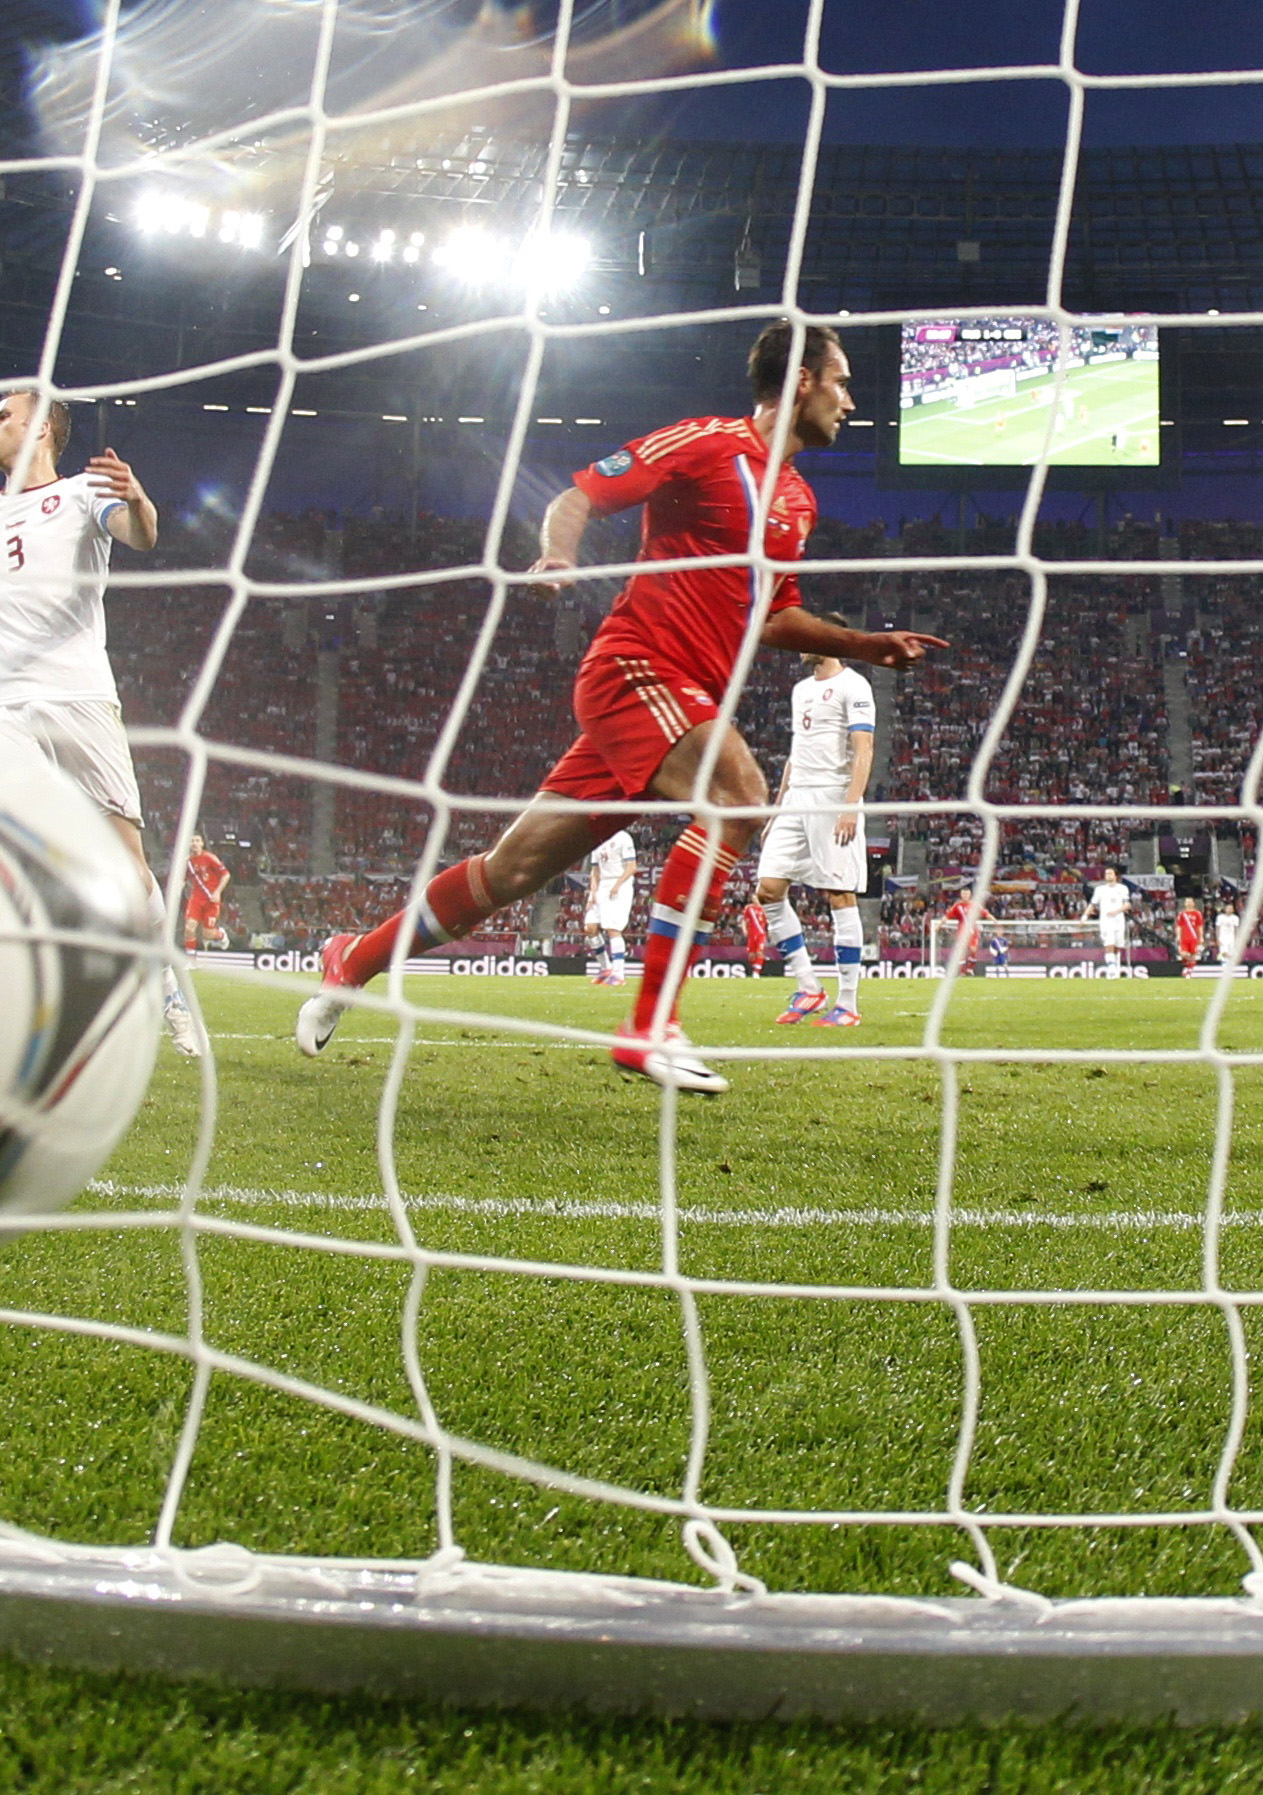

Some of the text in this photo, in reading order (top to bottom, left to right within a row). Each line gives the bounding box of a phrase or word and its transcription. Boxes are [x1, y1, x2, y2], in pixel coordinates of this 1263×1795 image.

[7, 535, 24, 572] 3
[802, 708, 812, 730] 6
[257, 950, 324, 972] adid
[452, 955, 549, 976] adidas
